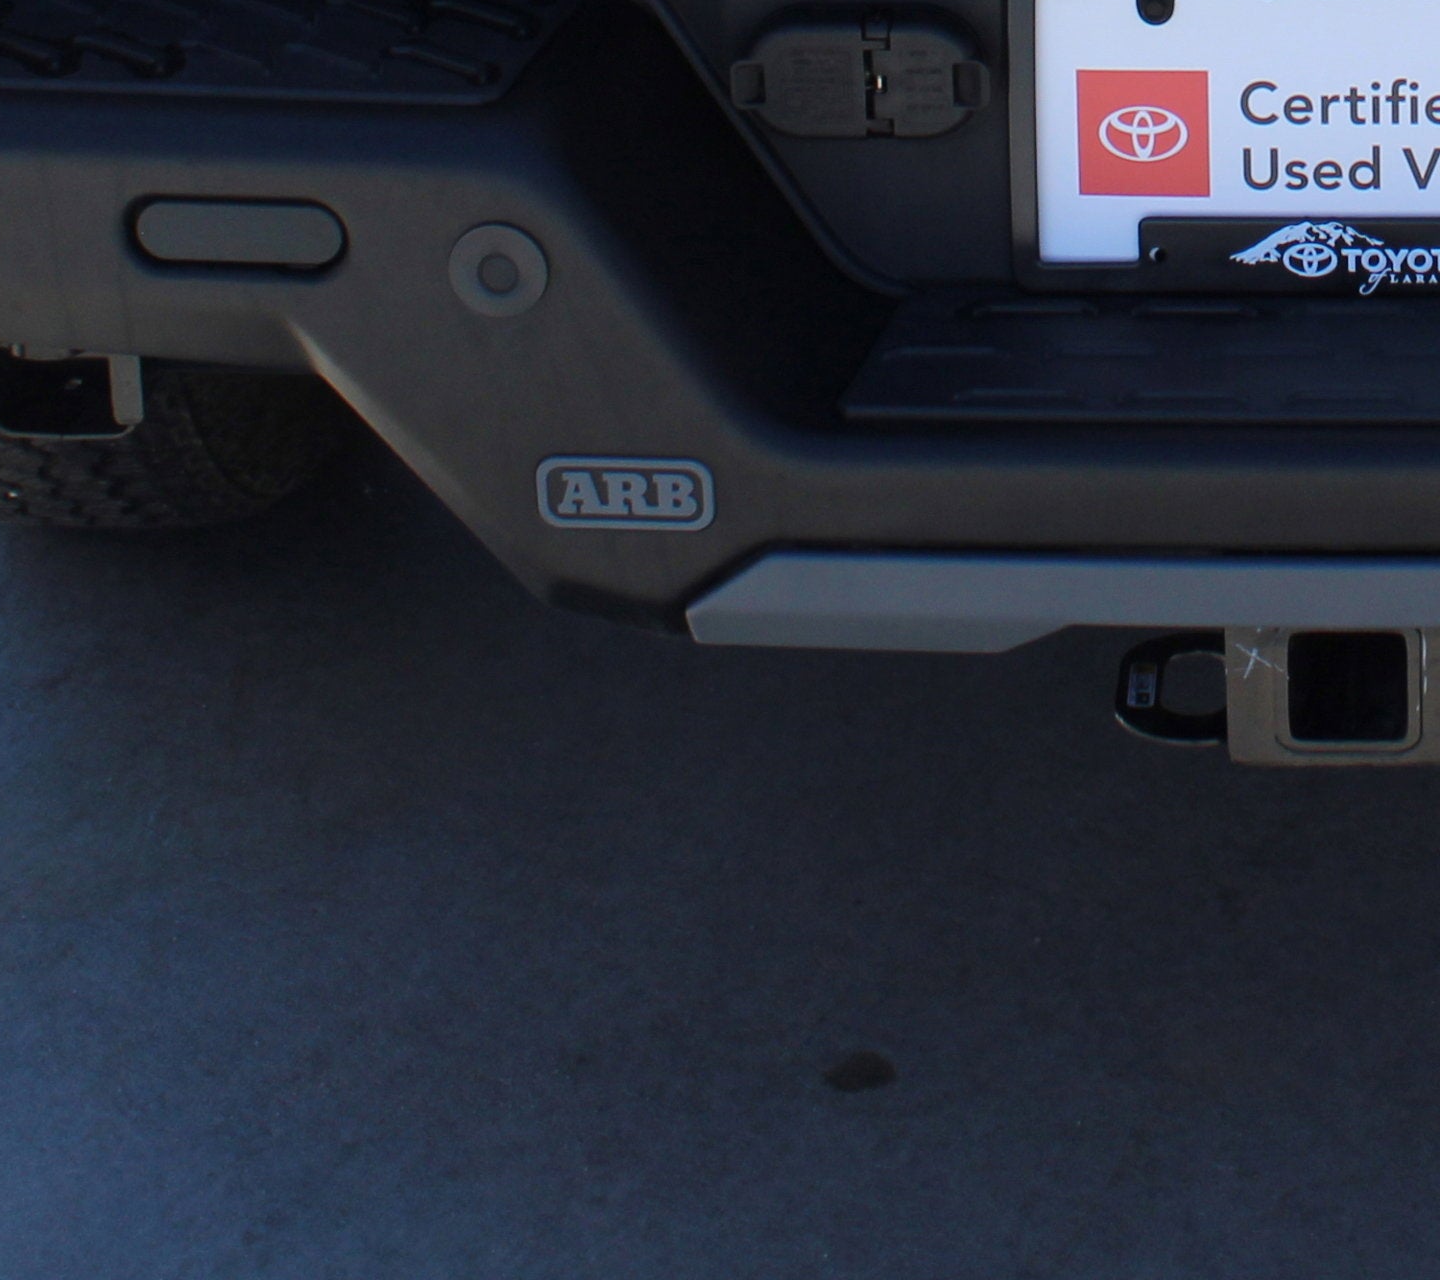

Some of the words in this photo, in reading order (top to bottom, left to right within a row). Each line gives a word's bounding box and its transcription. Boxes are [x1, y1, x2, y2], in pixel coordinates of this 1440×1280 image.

[1242, 145, 1381, 192] Used
[1359, 270, 1387, 296] of
[557, 471, 697, 517] ARB
